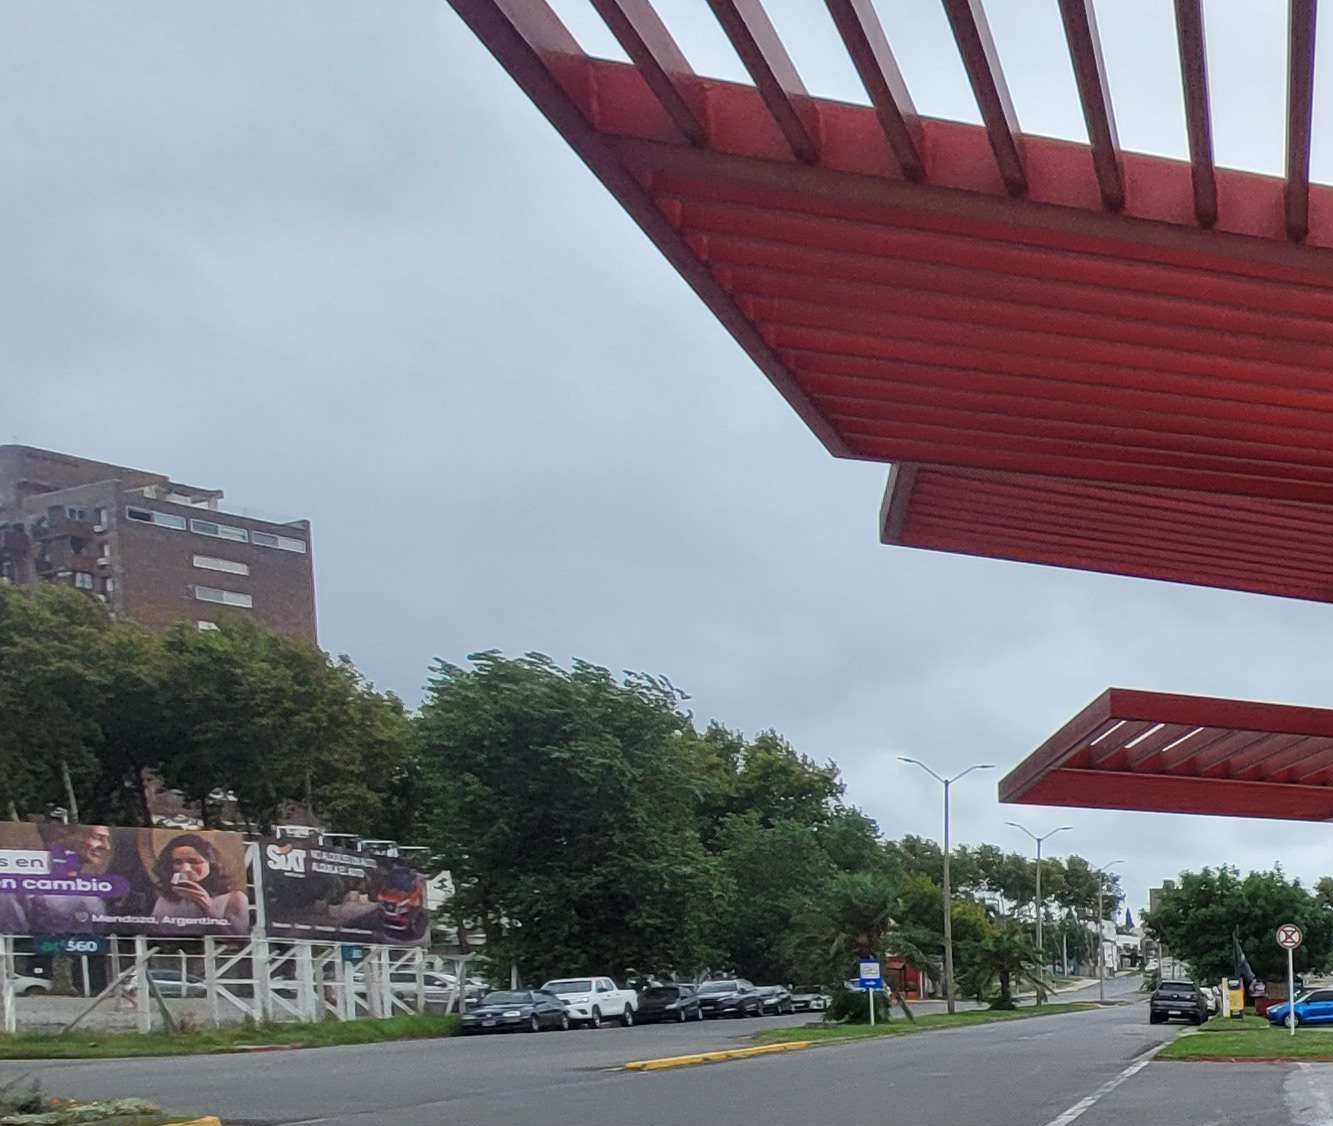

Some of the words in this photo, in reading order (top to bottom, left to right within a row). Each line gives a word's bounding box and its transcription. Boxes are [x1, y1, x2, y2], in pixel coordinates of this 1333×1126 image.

[16, 858, 45, 868] en
[22, 878, 113, 892] cambio
[92, 914, 159, 924] Mendoza,
